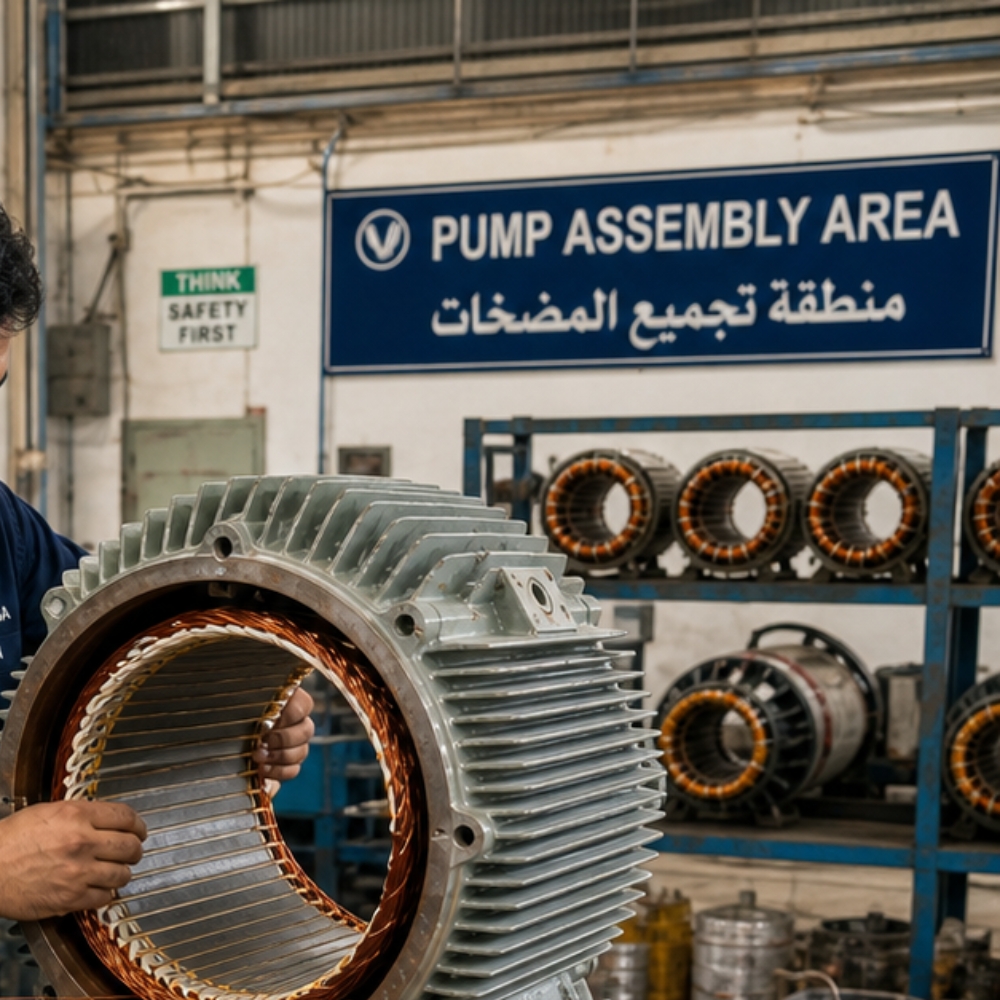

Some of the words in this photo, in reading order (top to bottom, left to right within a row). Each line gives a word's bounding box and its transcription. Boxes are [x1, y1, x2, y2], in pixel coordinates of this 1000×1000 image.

[432, 210, 552, 261] PUMP
[562, 196, 811, 255] ASSEMBLY
[820, 189, 960, 244] AREA
[175, 269, 241, 293] THINK
[768, 277, 906, 324] منطقة
[168, 300, 248, 321] SAFETY
[179, 323, 236, 343] FIRST
[431, 287, 618, 336] المضخات
[629, 283, 757, 350] تجميع
